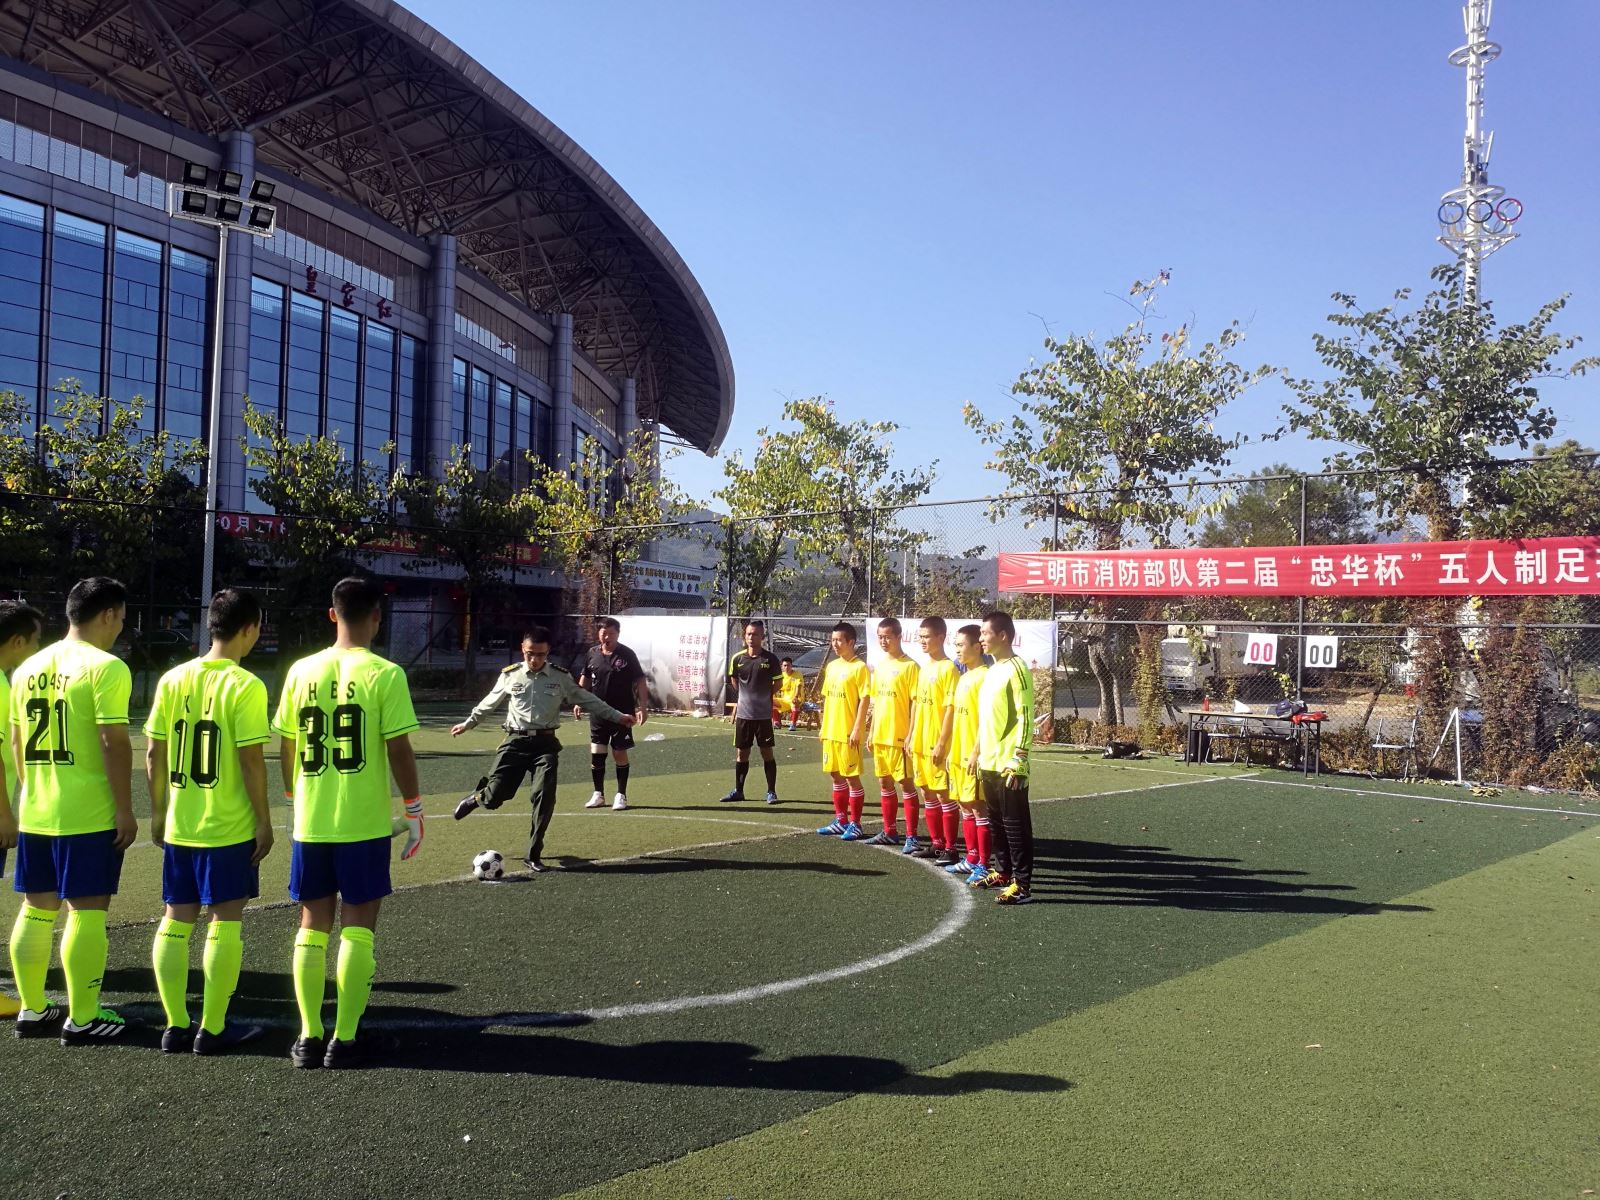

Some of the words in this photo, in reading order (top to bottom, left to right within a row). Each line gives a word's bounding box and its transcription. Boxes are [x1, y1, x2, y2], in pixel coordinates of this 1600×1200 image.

[1026, 547, 1600, 589] 三明市消防部队第二届“忠华杯”五人制足
[1250, 642, 1273, 662] 00
[1309, 644, 1333, 666] 00
[28, 672, 70, 692] COAST
[25, 698, 74, 765] 21
[299, 704, 366, 777] 39
[171, 718, 221, 789] 10
